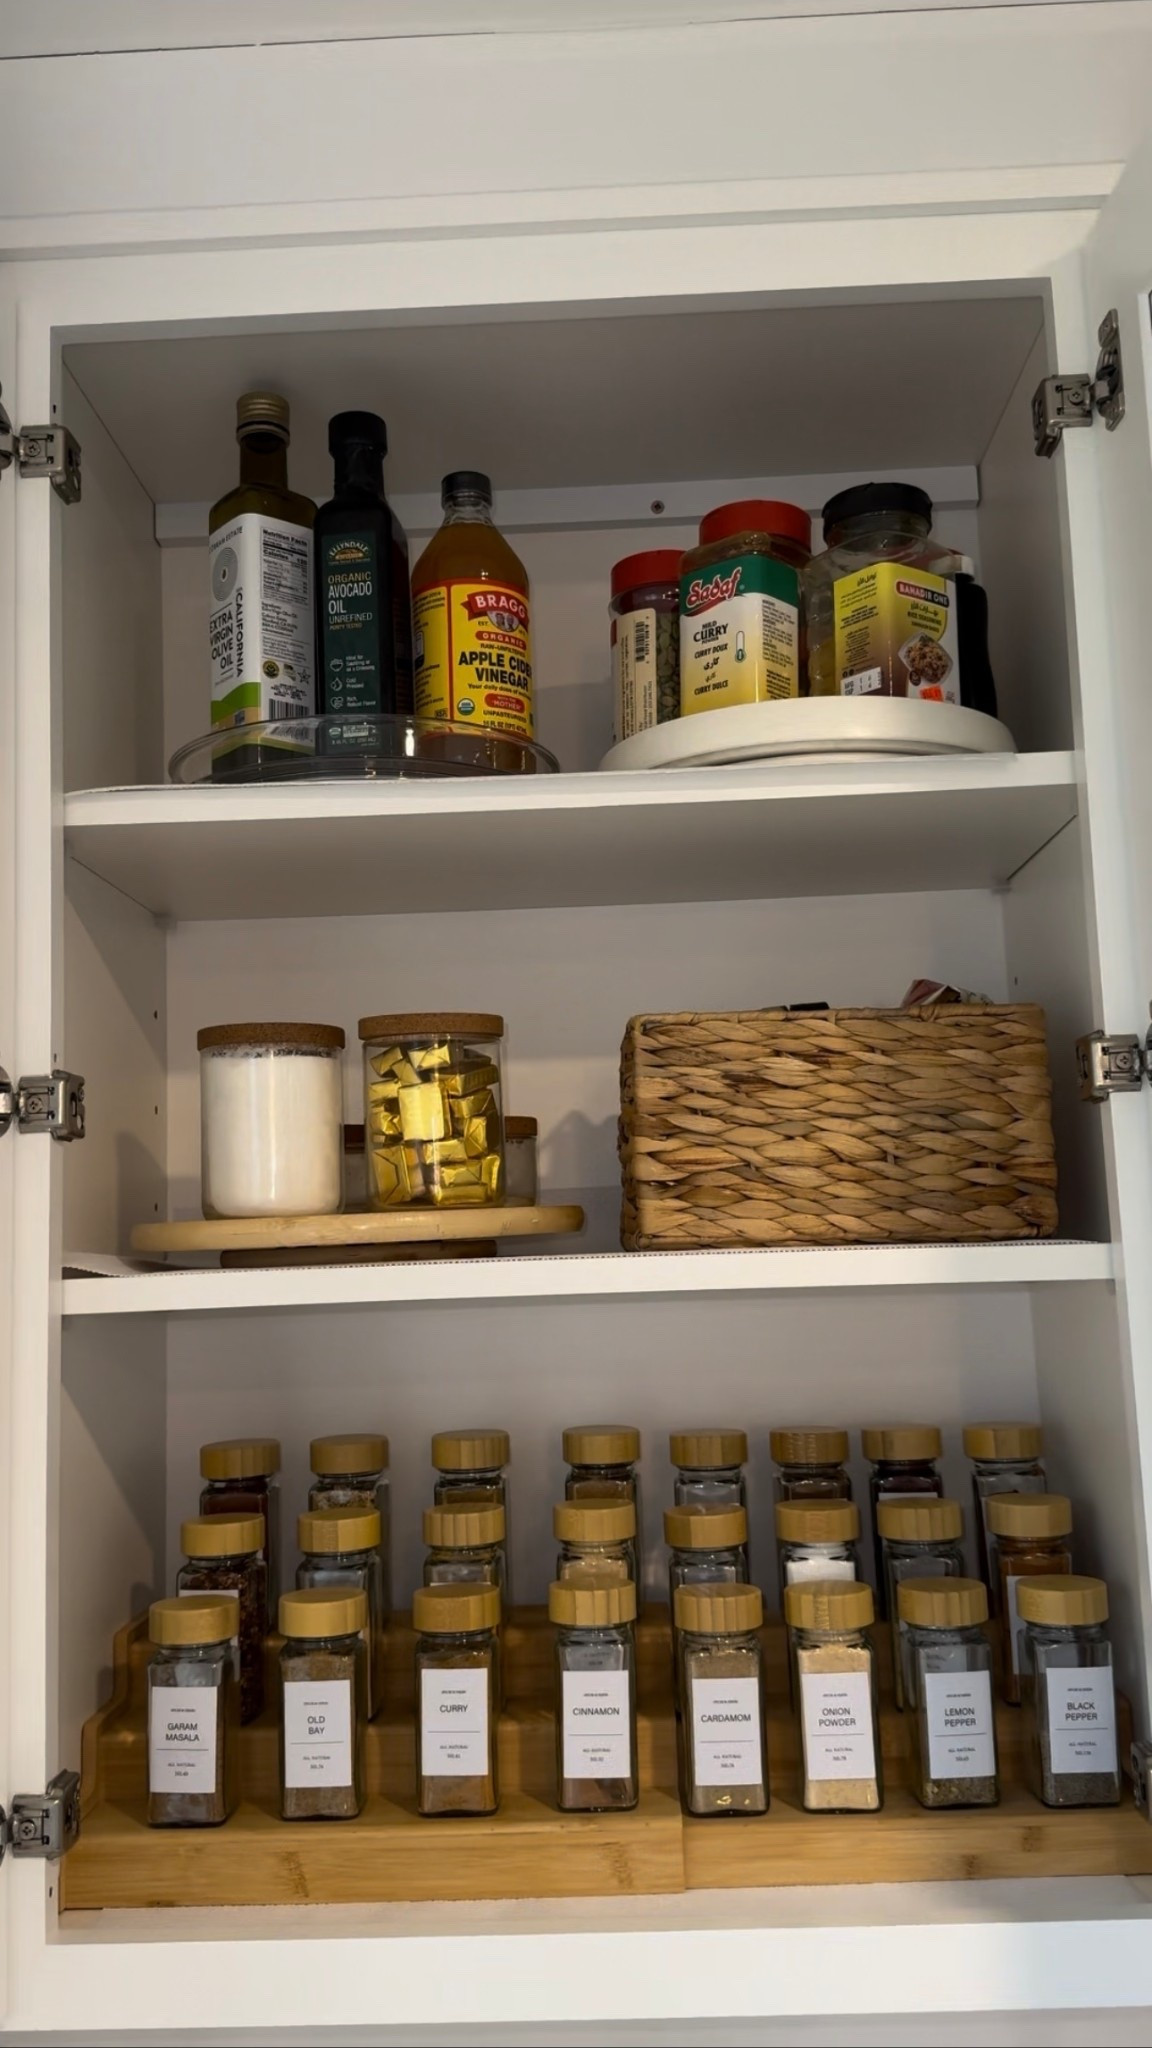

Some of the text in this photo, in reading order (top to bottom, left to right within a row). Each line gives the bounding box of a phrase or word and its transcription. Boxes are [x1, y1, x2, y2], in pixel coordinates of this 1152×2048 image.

[328, 571, 372, 584] ORGANIC
[328, 581, 372, 599] AVOCADO
[686, 566, 742, 608] Sadaf
[933, 593, 948, 605] ONE
[328, 599, 347, 614] OIL
[475, 594, 526, 618] BRAGG
[210, 611, 233, 634] EXTRA
[329, 612, 373, 624] UNREFINED
[702, 620, 717, 631] MILD
[210, 624, 233, 647] VIRGIN
[236, 592, 244, 678] CALIFORNIA
[693, 624, 728, 643] CURRY
[482, 632, 524, 648] ORGANIC
[211, 637, 233, 660] OLIVE
[694, 643, 728, 659] CURRY DOUX
[220, 655, 234, 670] OIL
[458, 651, 505, 668] APPLE
[475, 668, 529, 692] VINEGAR
[694, 680, 729, 696] CURRY DULCE
[439, 1704, 468, 1713] CURRY
[572, 1707, 620, 1716] CINNAMON
[822, 1707, 851, 1716] ONION
[944, 1707, 975, 1717] LEMON
[1067, 1702, 1096, 1711] BLACK
[307, 1715, 325, 1724] OLD
[701, 1713, 751, 1723] CARDAMOM
[818, 1718, 856, 1727] POWDER
[944, 1717, 976, 1727] PEPPER
[1065, 1712, 1098, 1721] PEPPER
[167, 1722, 198, 1731] GARAM
[308, 1727, 325, 1735] BAY
[165, 1733, 199, 1742] MASALA
